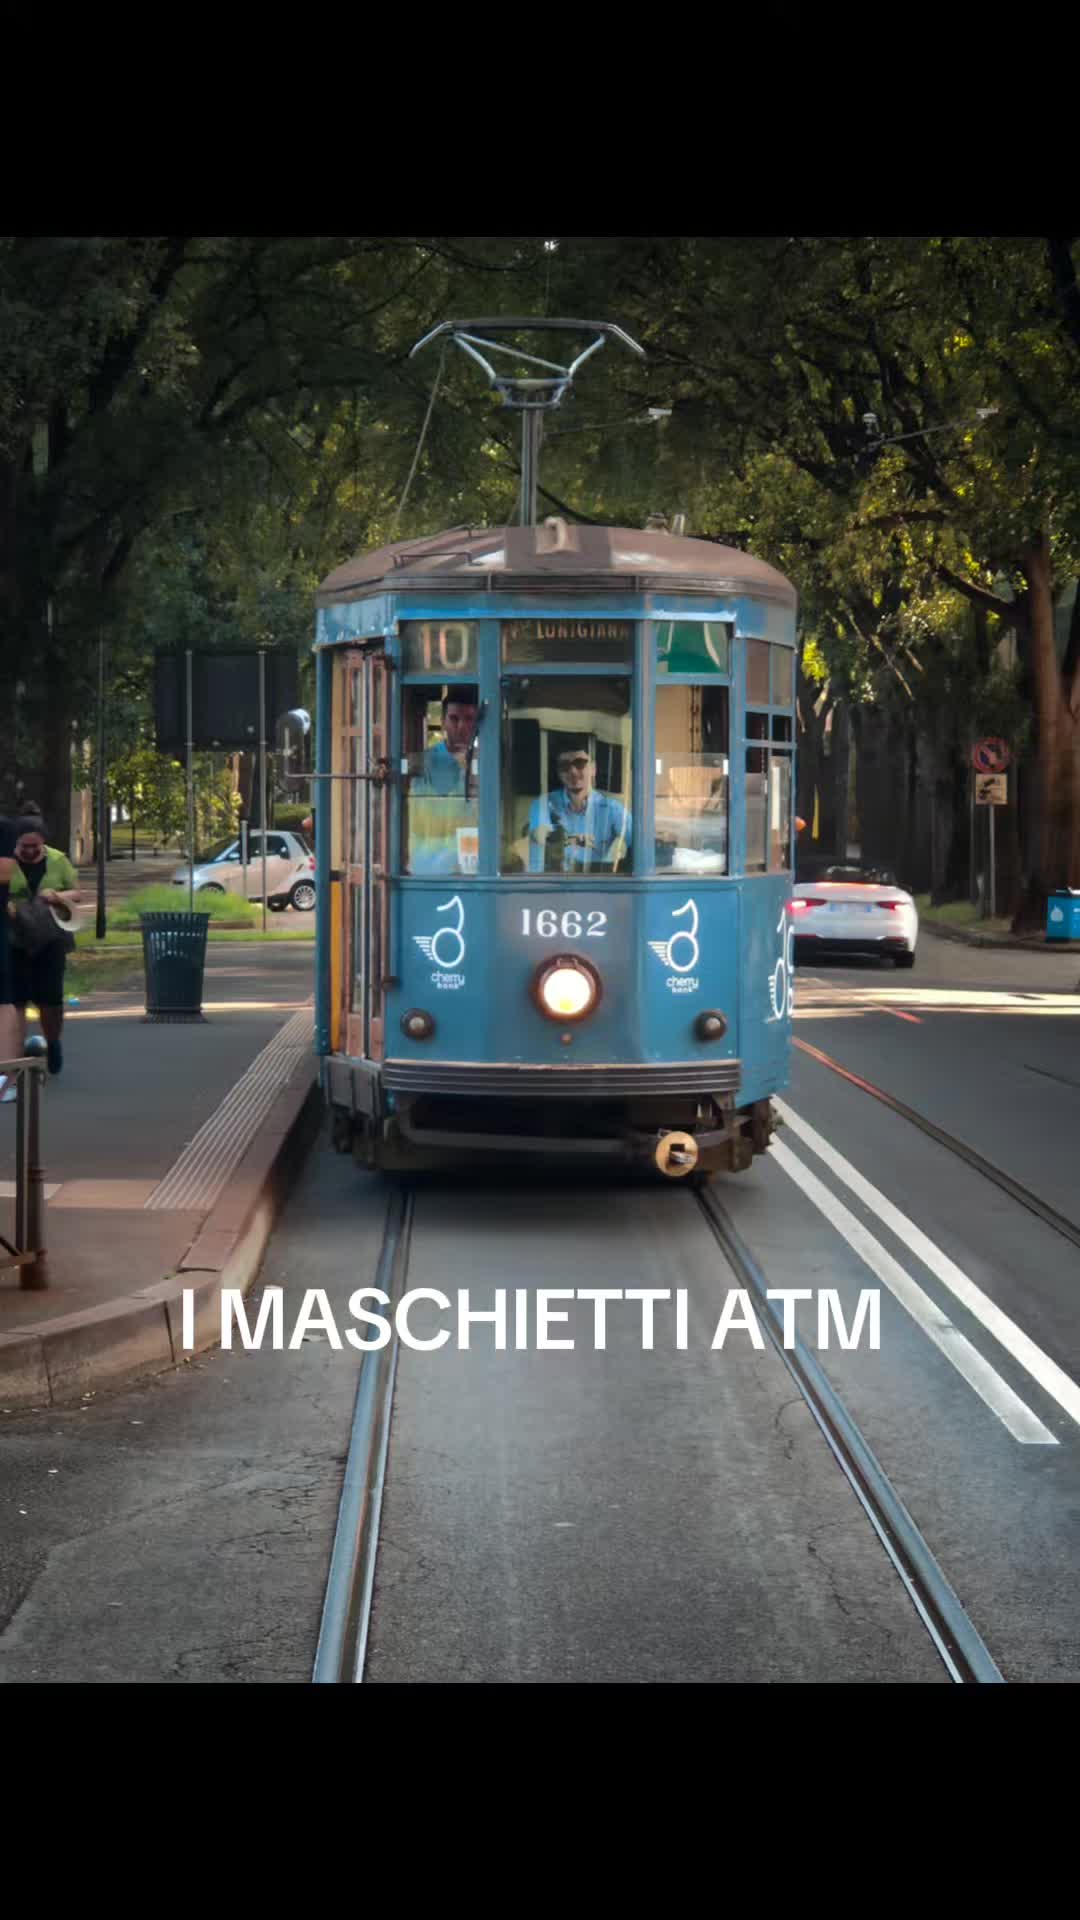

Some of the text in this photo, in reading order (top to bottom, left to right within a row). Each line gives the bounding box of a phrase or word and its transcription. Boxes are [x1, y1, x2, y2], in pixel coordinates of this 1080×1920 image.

[421, 622, 469, 670] 10
[521, 908, 608, 938] 1662
[430, 970, 465, 986] cherry
[666, 975, 699, 989] cherry
